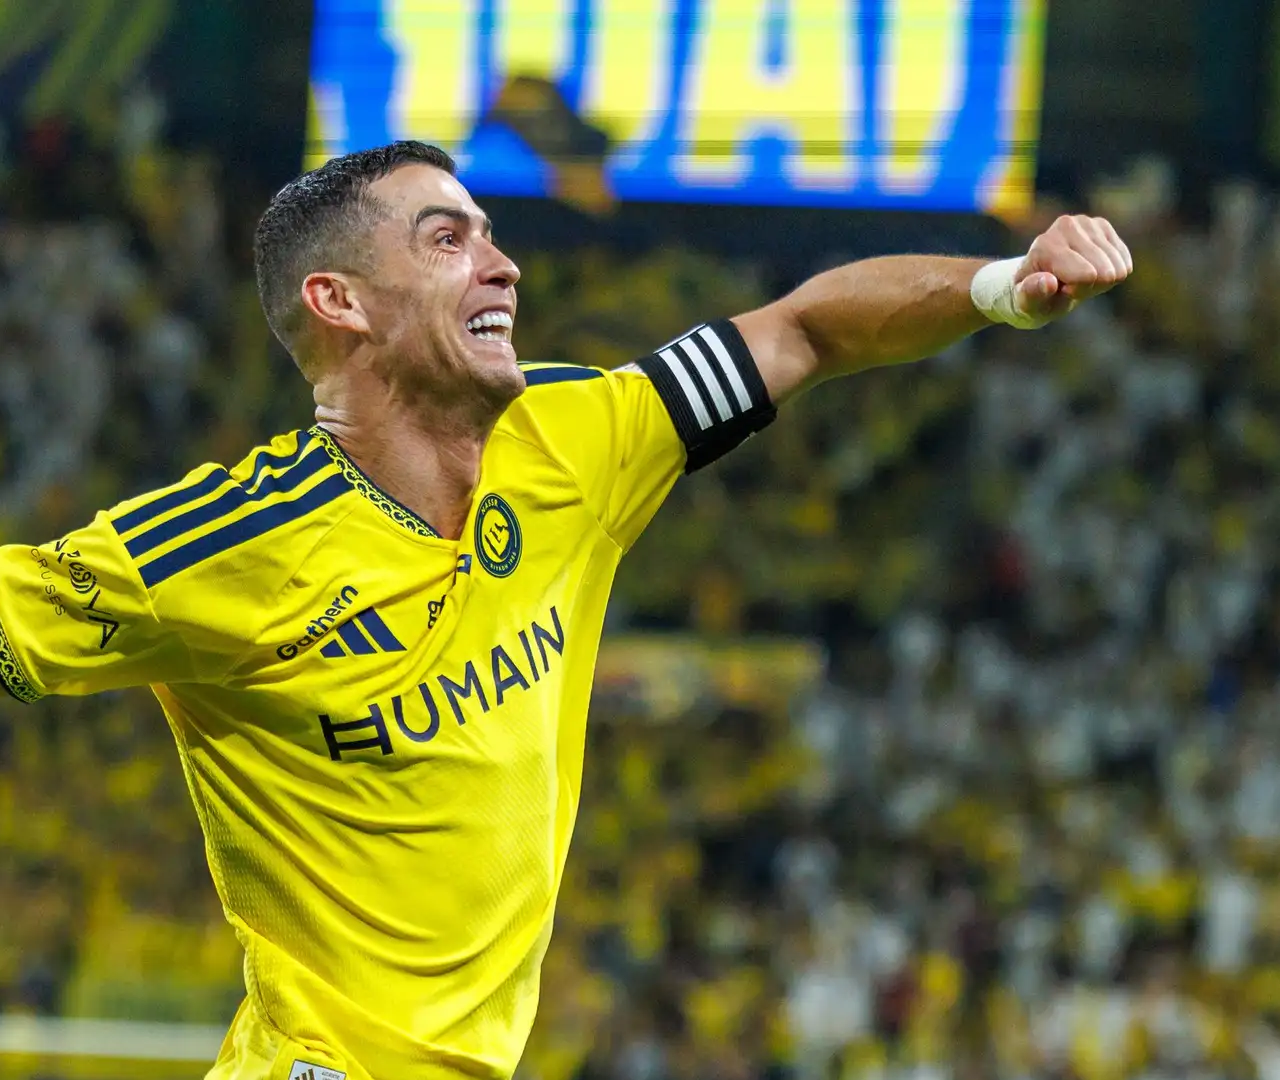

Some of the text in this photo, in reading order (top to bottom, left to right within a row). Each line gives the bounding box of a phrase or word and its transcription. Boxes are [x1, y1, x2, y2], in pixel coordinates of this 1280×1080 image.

[481, 499, 498, 515] NASSR
[276, 585, 359, 661] Gathern
[319, 606, 565, 761] HUMAIN
